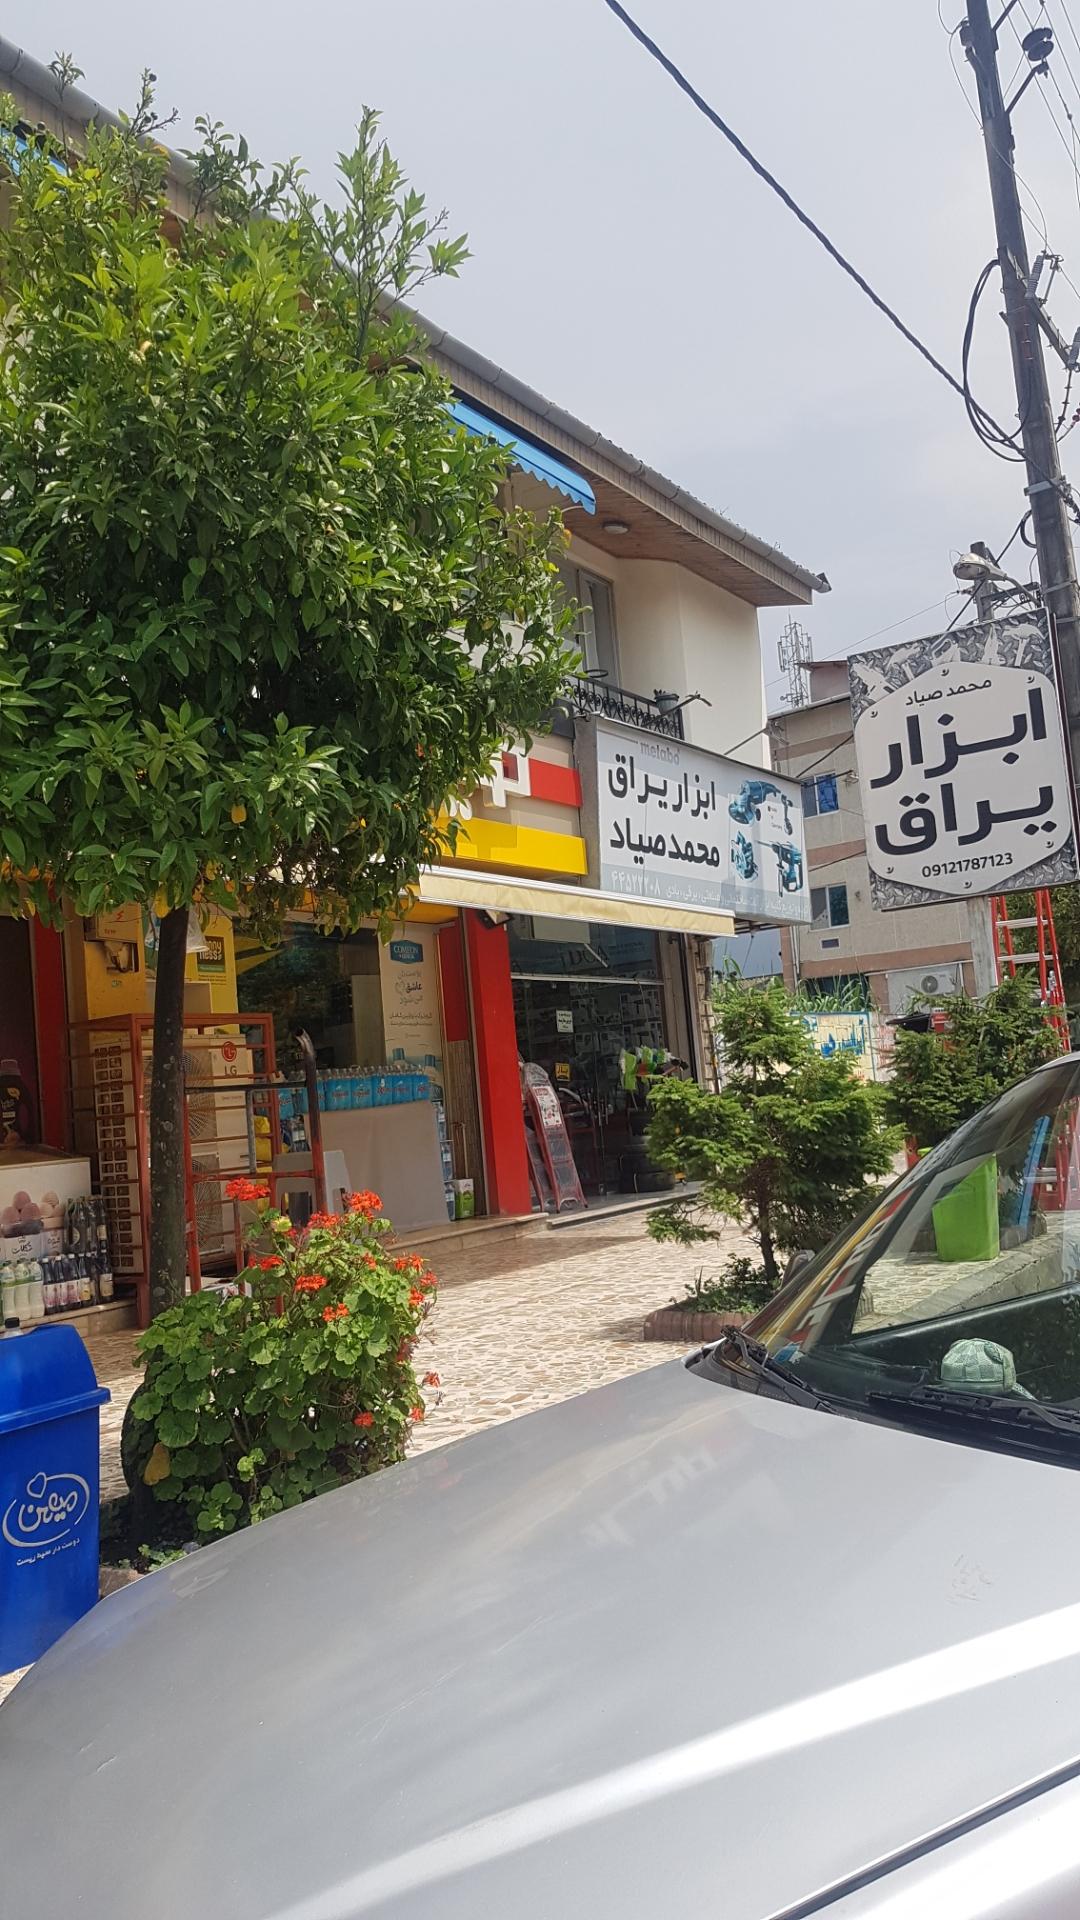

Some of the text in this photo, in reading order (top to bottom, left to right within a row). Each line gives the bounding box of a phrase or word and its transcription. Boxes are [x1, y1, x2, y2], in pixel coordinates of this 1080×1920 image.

[904, 678, 993, 707] محمد صیاد
[870, 687, 1048, 789] ابزار
[607, 753, 668, 810] یراق
[672, 772, 716, 820] ابزار
[609, 817, 720, 868] محمد صیاد
[874, 782, 1057, 856] یراق
[921, 852, 1014, 878] 09121787123
